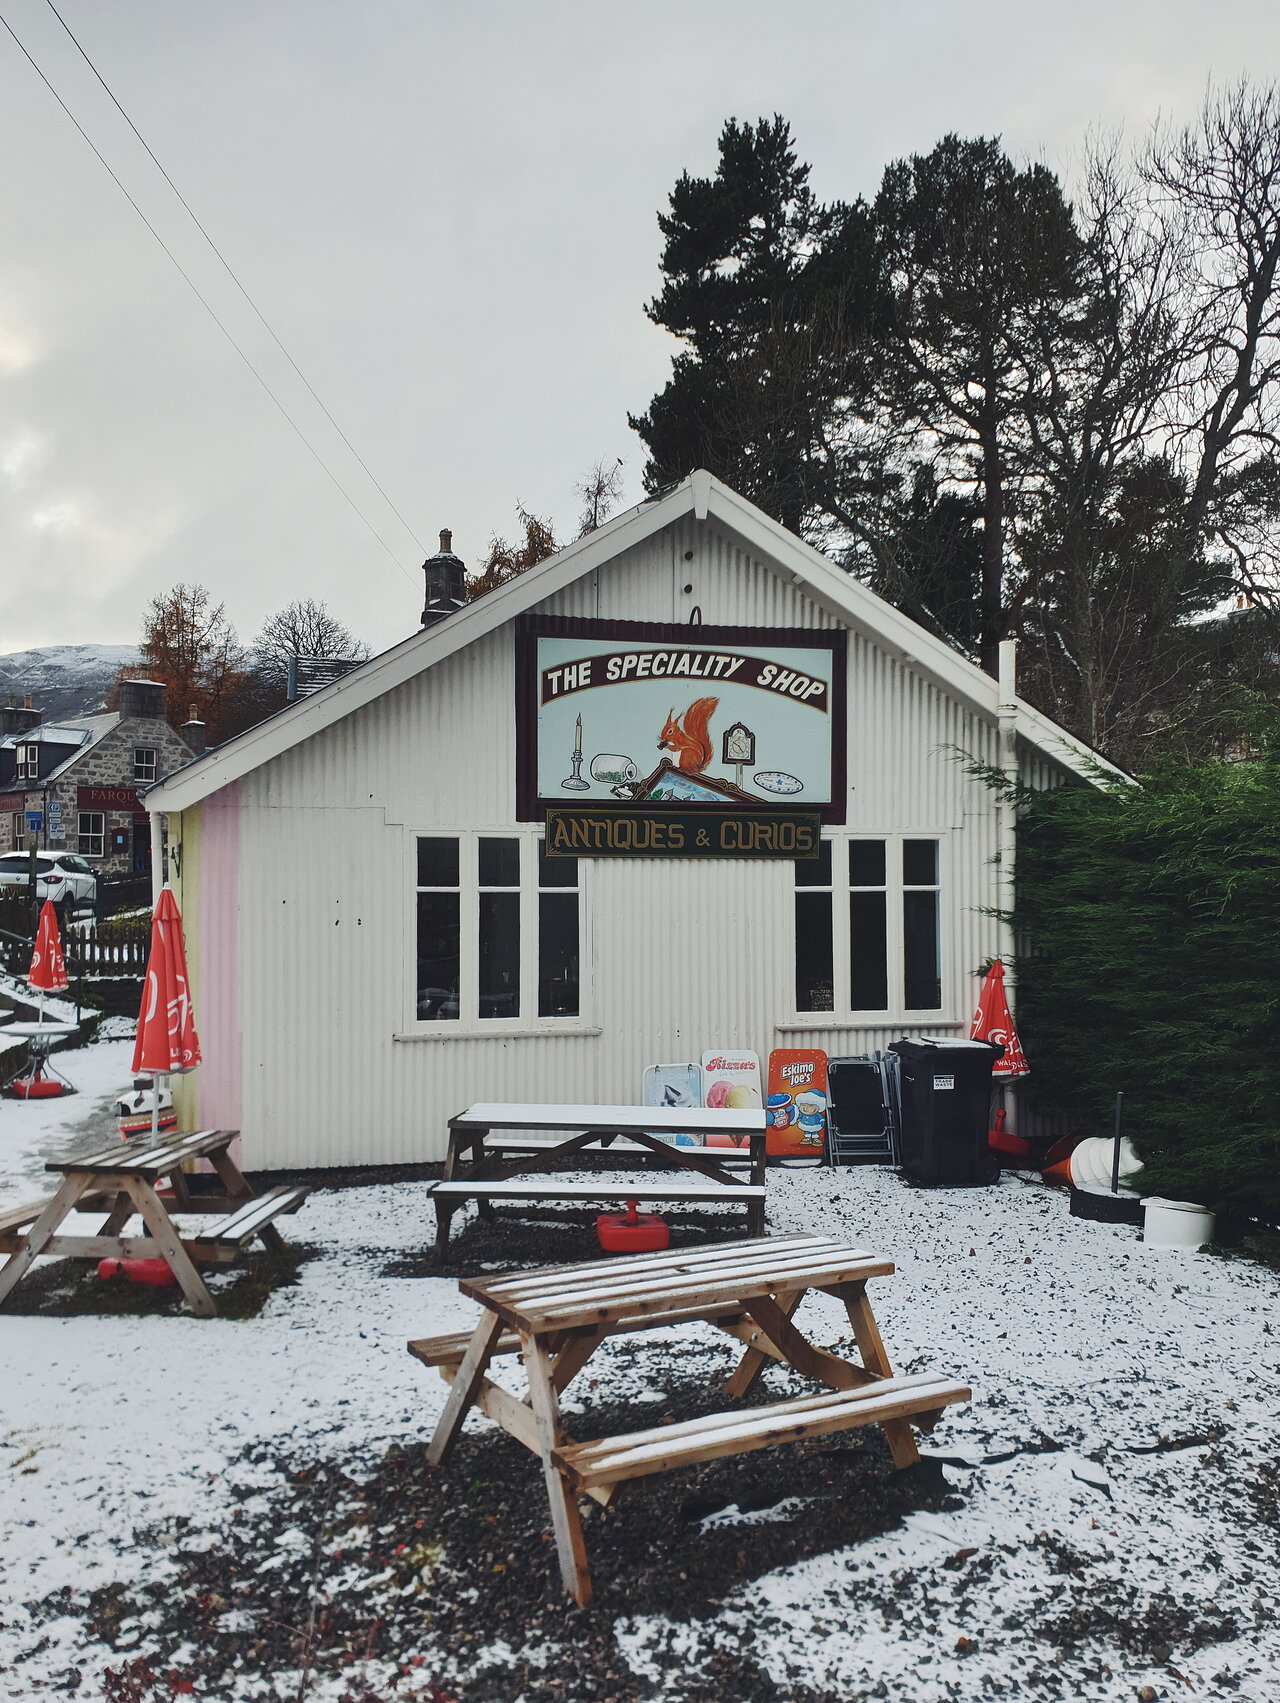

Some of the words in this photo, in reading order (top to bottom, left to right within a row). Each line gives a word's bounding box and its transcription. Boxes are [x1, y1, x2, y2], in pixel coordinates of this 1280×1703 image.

[547, 660, 591, 695] THE
[606, 652, 746, 681] SPECIALITY
[756, 664, 825, 701] SHOP
[552, 818, 685, 849] ANTIQUES
[695, 828, 711, 847] &
[720, 822, 813, 851] CURIOS
[781, 1062, 815, 1078] Eskimo
[790, 1072, 812, 1086] Joe's
